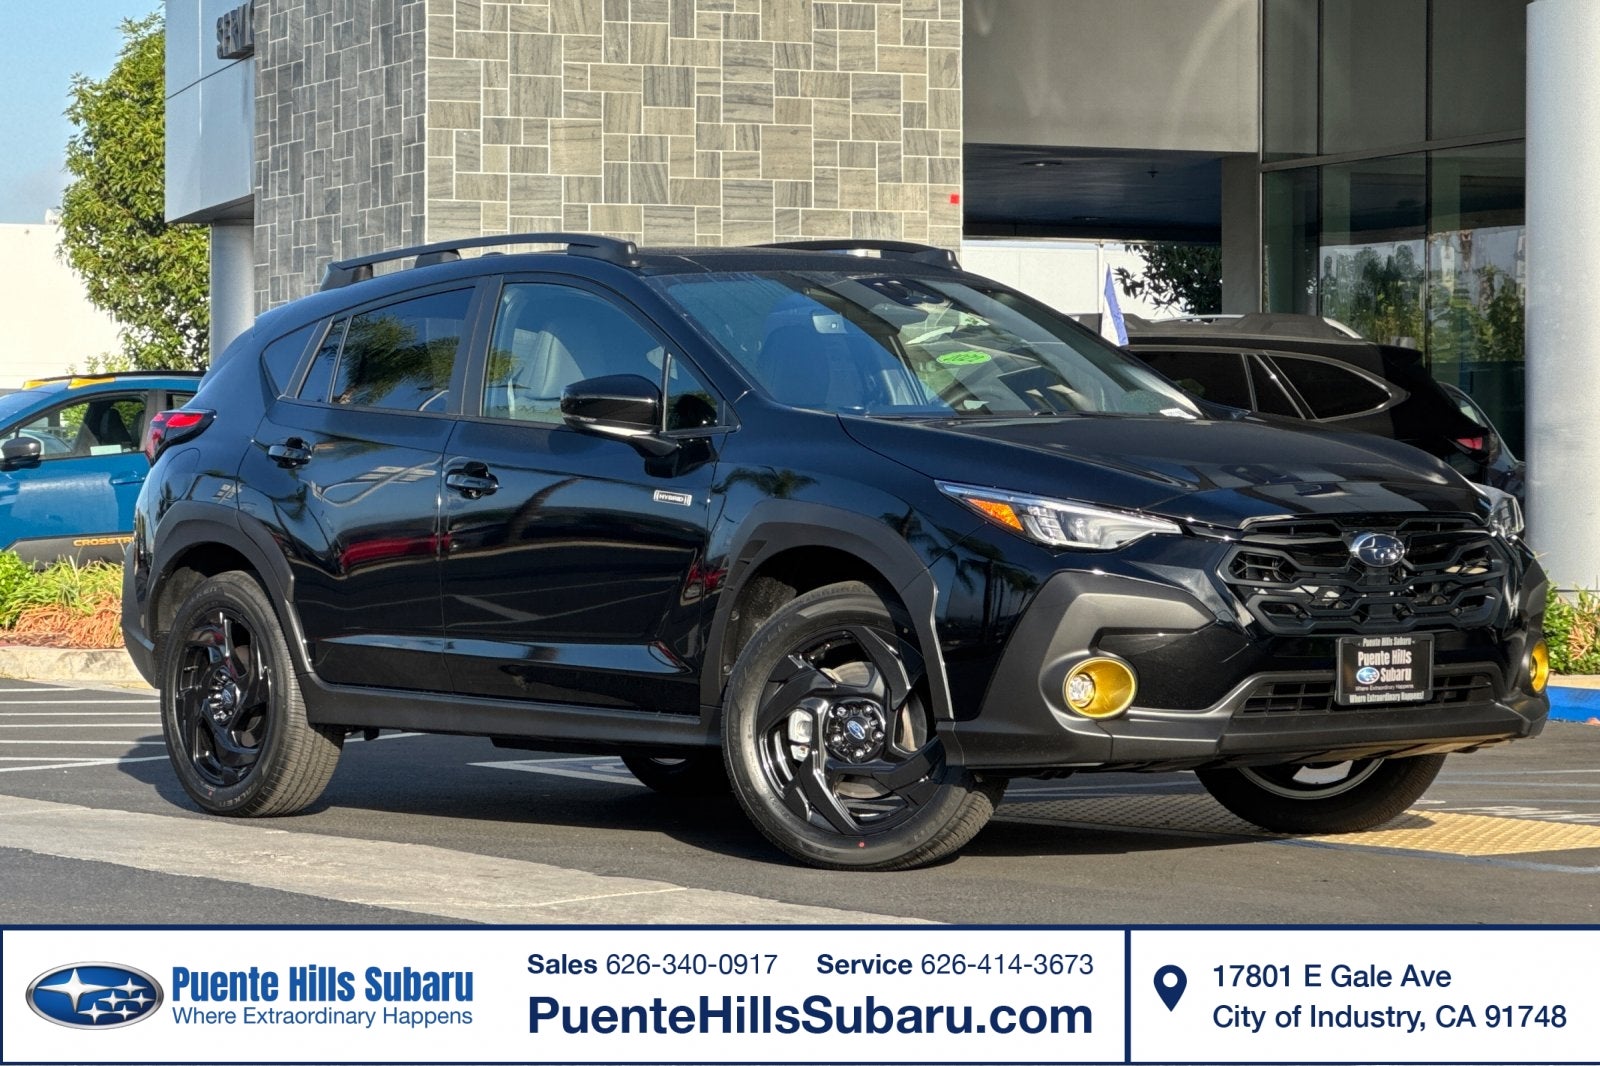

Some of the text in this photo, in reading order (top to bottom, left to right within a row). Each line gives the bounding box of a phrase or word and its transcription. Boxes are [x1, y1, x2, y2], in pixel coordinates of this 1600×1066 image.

[659, 494, 684, 502] HYBRID
[1363, 637, 1412, 647] Puente Hills Subaru
[1358, 649, 1412, 666] Puente Hills
[1381, 667, 1412, 682] Subaru
[1349, 694, 1366, 704] Where
[1366, 693, 1400, 702] Extraordinary
